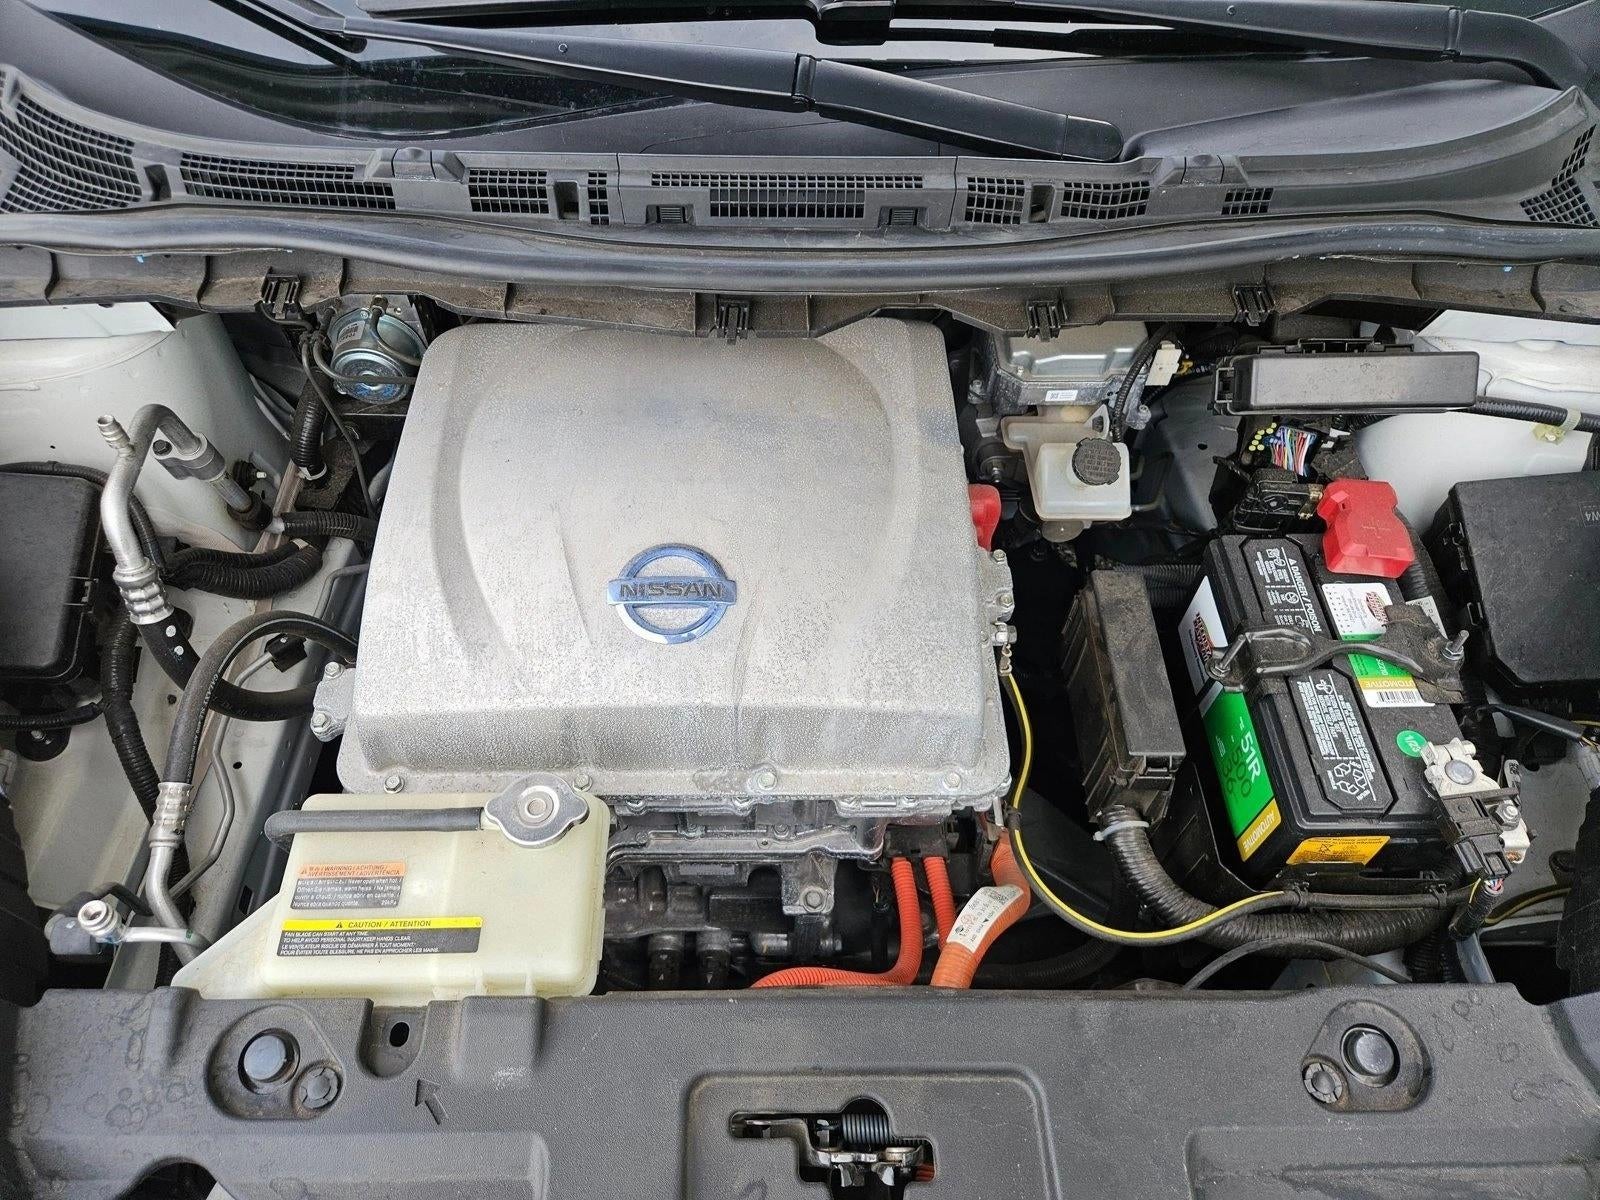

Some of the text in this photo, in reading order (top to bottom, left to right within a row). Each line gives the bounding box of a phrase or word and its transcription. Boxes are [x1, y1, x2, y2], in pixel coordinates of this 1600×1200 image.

[619, 581, 722, 598] NISSAN
[1291, 566, 1309, 596] DANGER
[1305, 604, 1322, 631] POISON
[1241, 731, 1261, 784] 51R
[1243, 810, 1275, 852] AUTOMOTIVE
